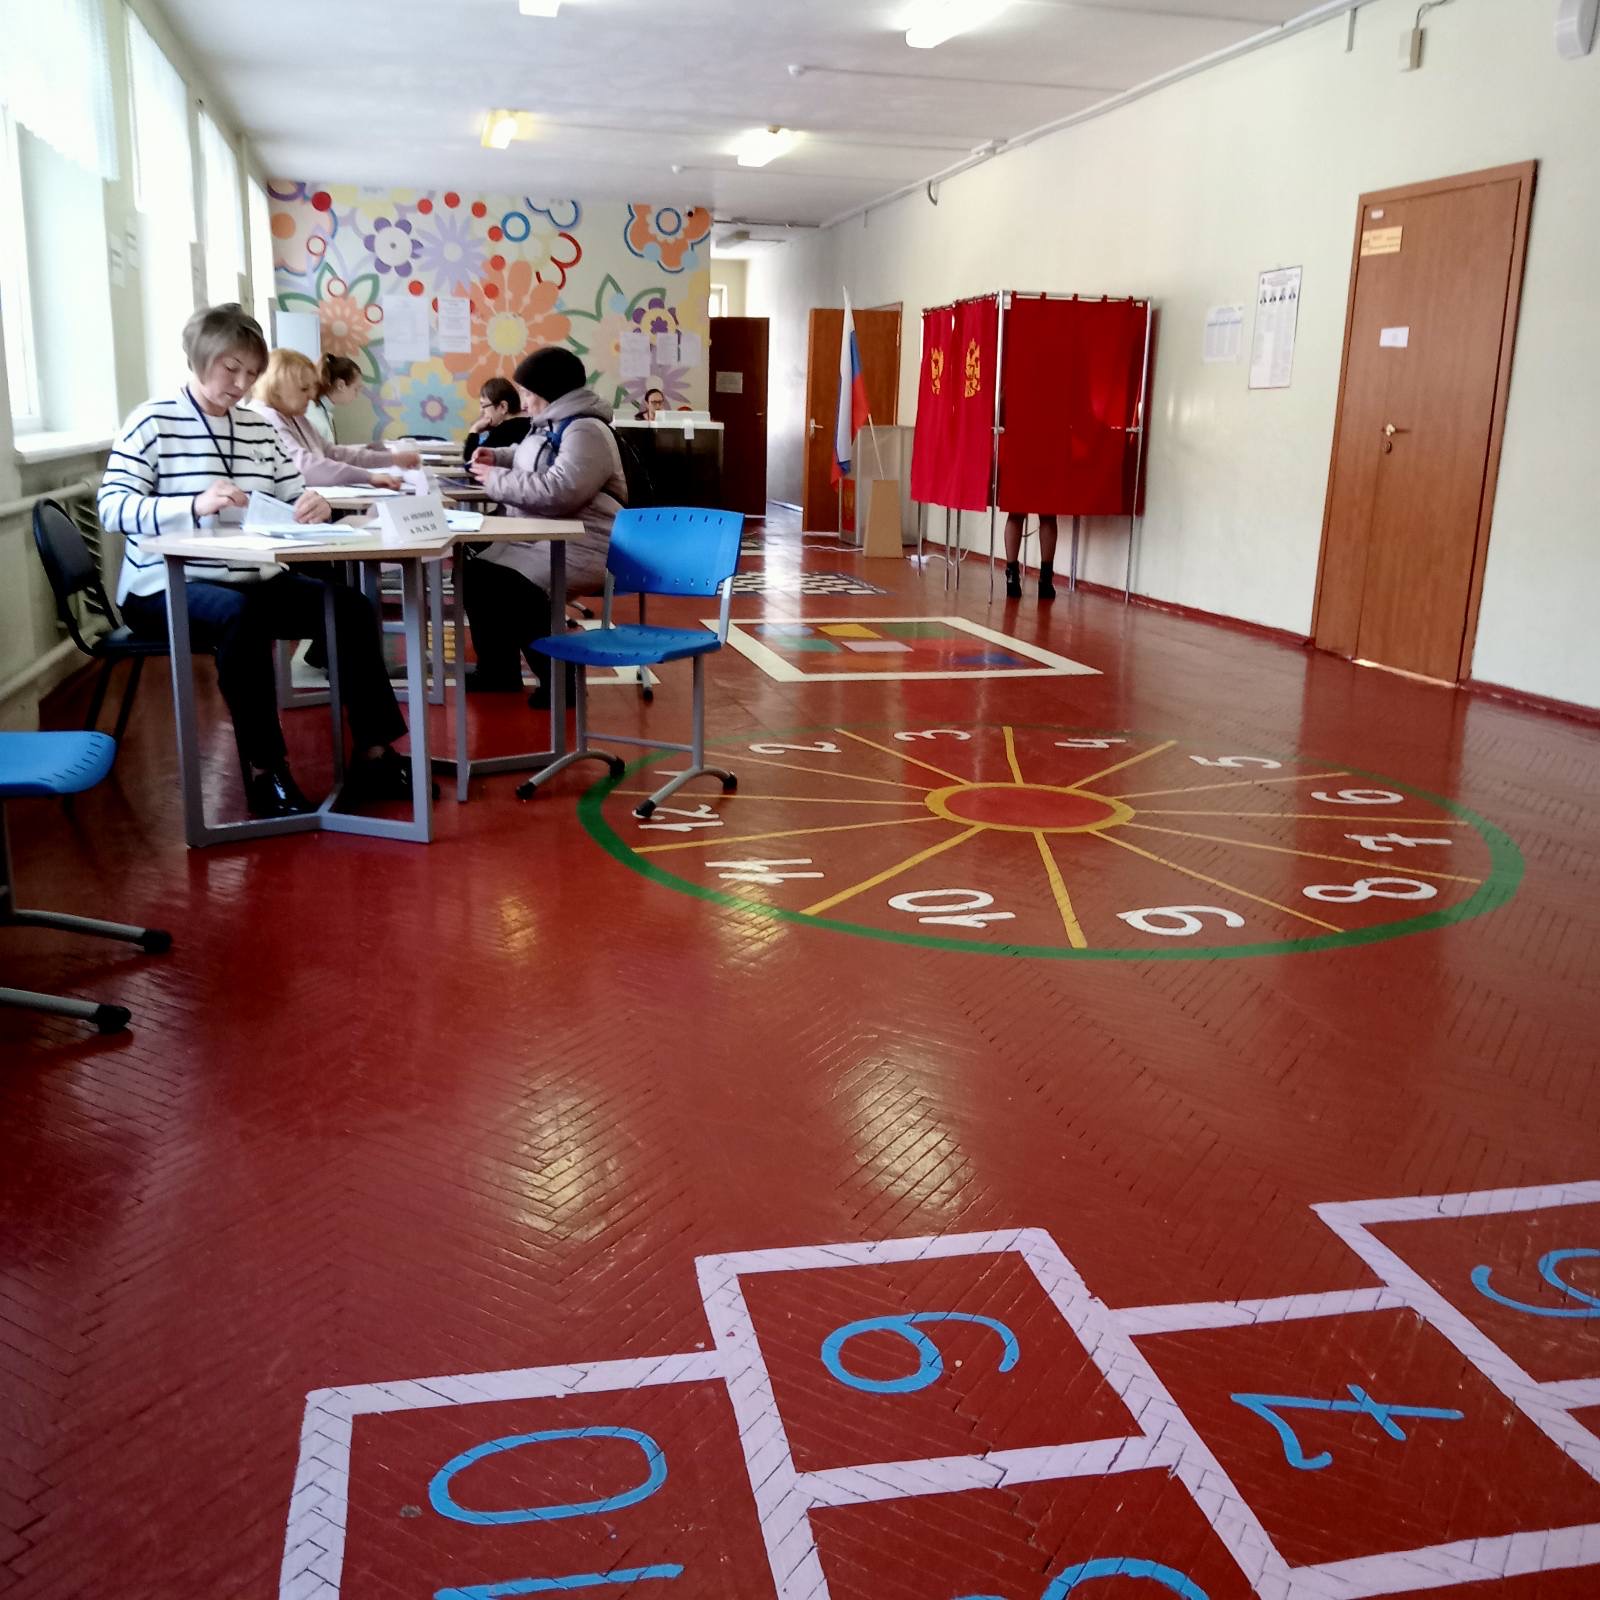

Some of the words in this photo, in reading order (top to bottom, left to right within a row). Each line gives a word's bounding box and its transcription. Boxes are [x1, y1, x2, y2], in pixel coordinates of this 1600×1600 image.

[748, 741, 842, 754] 2
[893, 729, 971, 742] 3
[1054, 737, 1127, 749] 4
[1189, 755, 1282, 769] 5
[1310, 789, 1404, 805] 6
[1343, 832, 1452, 853] 7
[705, 858, 825, 885] 11
[1302, 876, 1438, 903] 8
[887, 888, 1016, 929] 10
[1115, 904, 1245, 937] 9
[820, 1311, 1020, 1395] 9
[1230, 1384, 1464, 1471] 7
